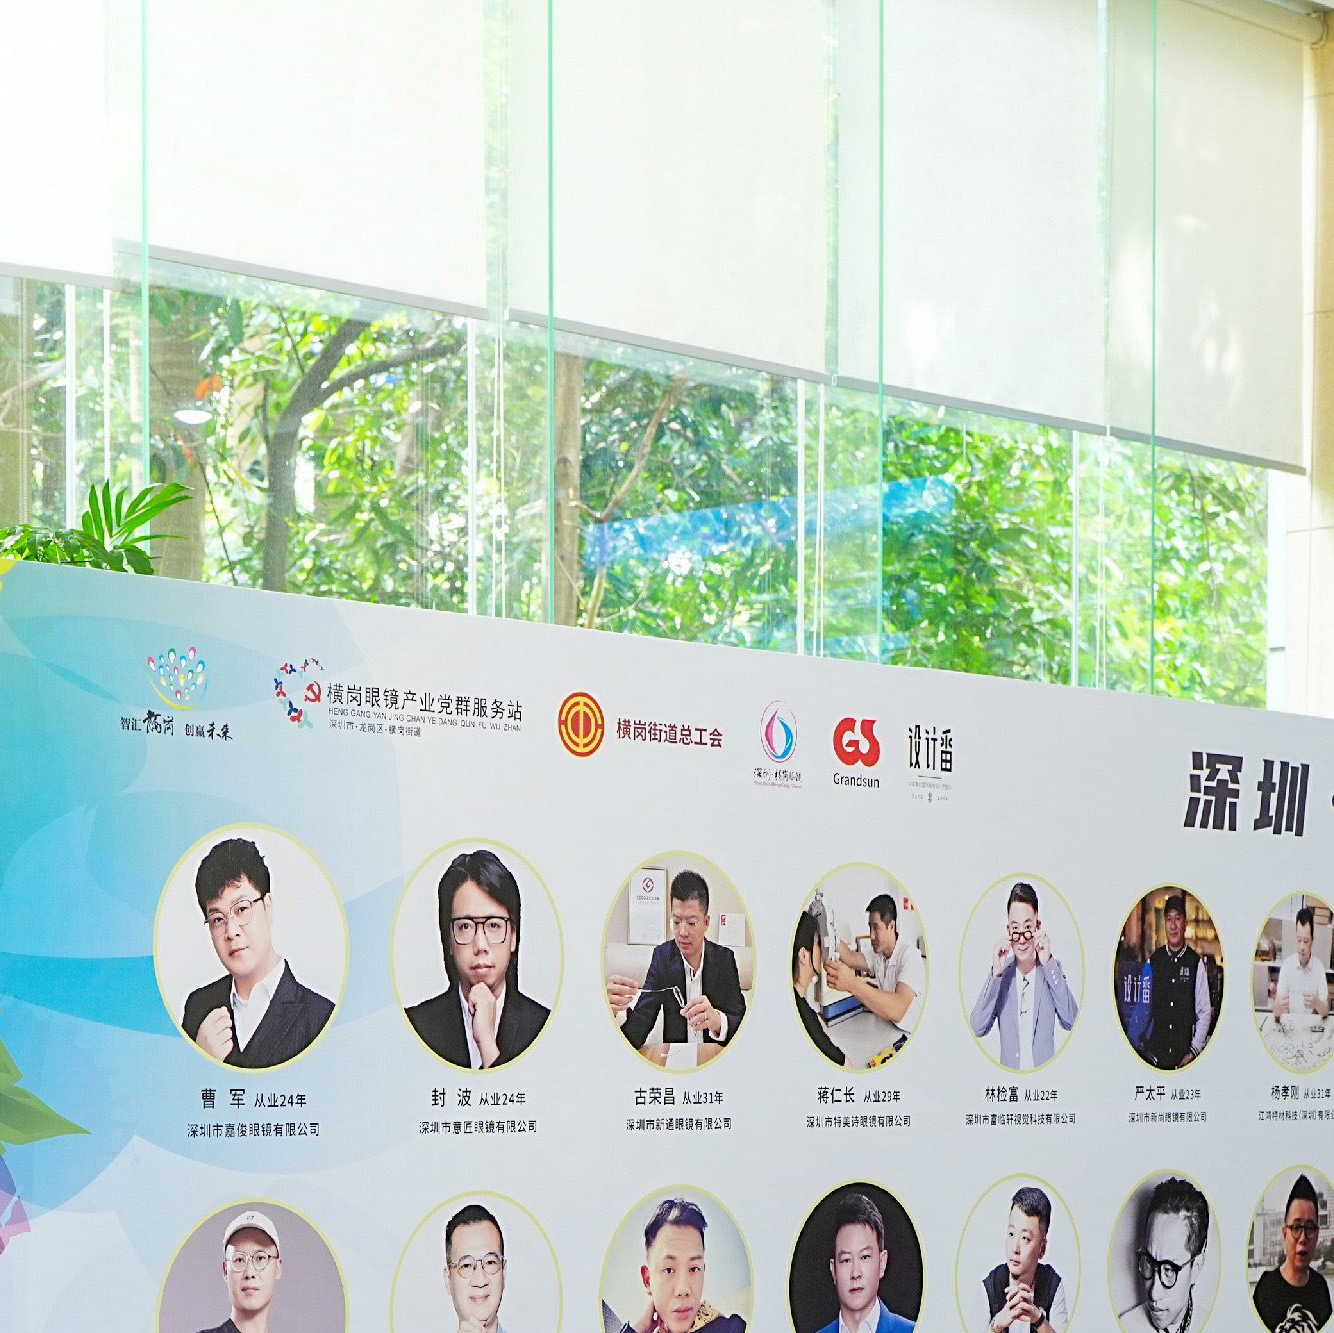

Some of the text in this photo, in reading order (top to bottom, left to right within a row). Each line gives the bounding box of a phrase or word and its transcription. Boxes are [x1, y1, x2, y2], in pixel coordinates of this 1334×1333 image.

[327, 682, 523, 722] 横岗眼镜产业党群服务站
[617, 717, 724, 749] 横岗街道总工会
[833, 772, 880, 788] Grandsun
[254, 1092, 306, 1108] 从业24年
[479, 1092, 525, 1106] 从业24年
[634, 1087, 723, 1105] 古荣昌 从业31年
[817, 1086, 900, 1104] 蒋仁长 从业29年
[1024, 1089, 1058, 1101] 从业22年
[1135, 1085, 1166, 1101] 严太平
[187, 1122, 319, 1138] 深圳市嘉俊眼镜有限公司
[419, 1120, 537, 1135] 深圳市意匠眼镜有限公司
[626, 1117, 732, 1131] 深圳市新通眼镜有限公司
[806, 1115, 911, 1129] 深圳市特美诗眼镜有限公司
